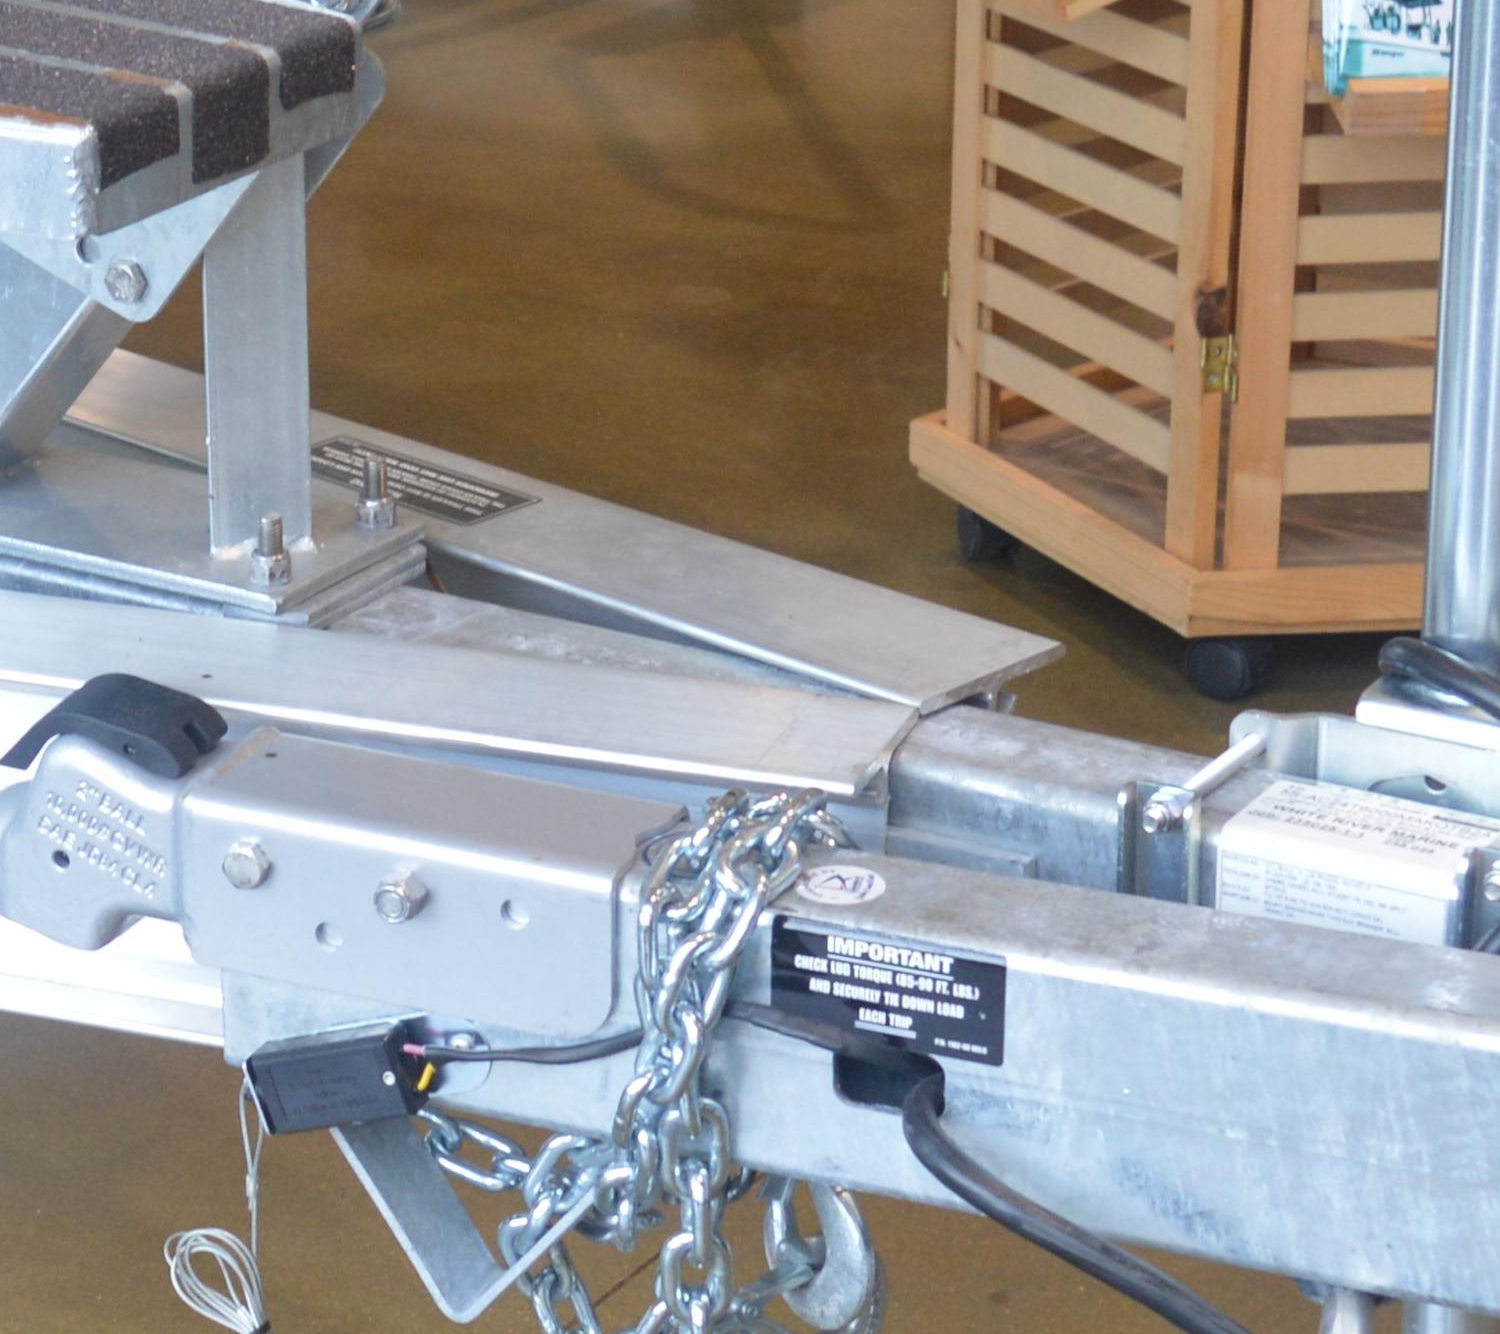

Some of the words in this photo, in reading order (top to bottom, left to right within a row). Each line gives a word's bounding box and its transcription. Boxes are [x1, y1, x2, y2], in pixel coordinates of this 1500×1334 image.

[1273, 804, 1324, 822] WHITE
[1333, 816, 1388, 834] RIVER
[1390, 829, 1460, 850] MARINE
[826, 936, 954, 974] IMPORTANT
[794, 954, 829, 973] CHECK
[831, 960, 851, 977] LUG
[853, 964, 893, 986] TORQUE
[896, 973, 934, 994] (85-90
[936, 980, 950, 995] FT.
[953, 982, 980, 1001] LBS.)
[809, 977, 831, 995] AND
[833, 981, 881, 1004] SECURELY
[884, 991, 900, 1007] TIE
[902, 995, 934, 1014] DOWN
[937, 1001, 965, 1020] LOAD
[859, 1007, 886, 1025] EACH
[889, 1013, 913, 1029] TRIP
